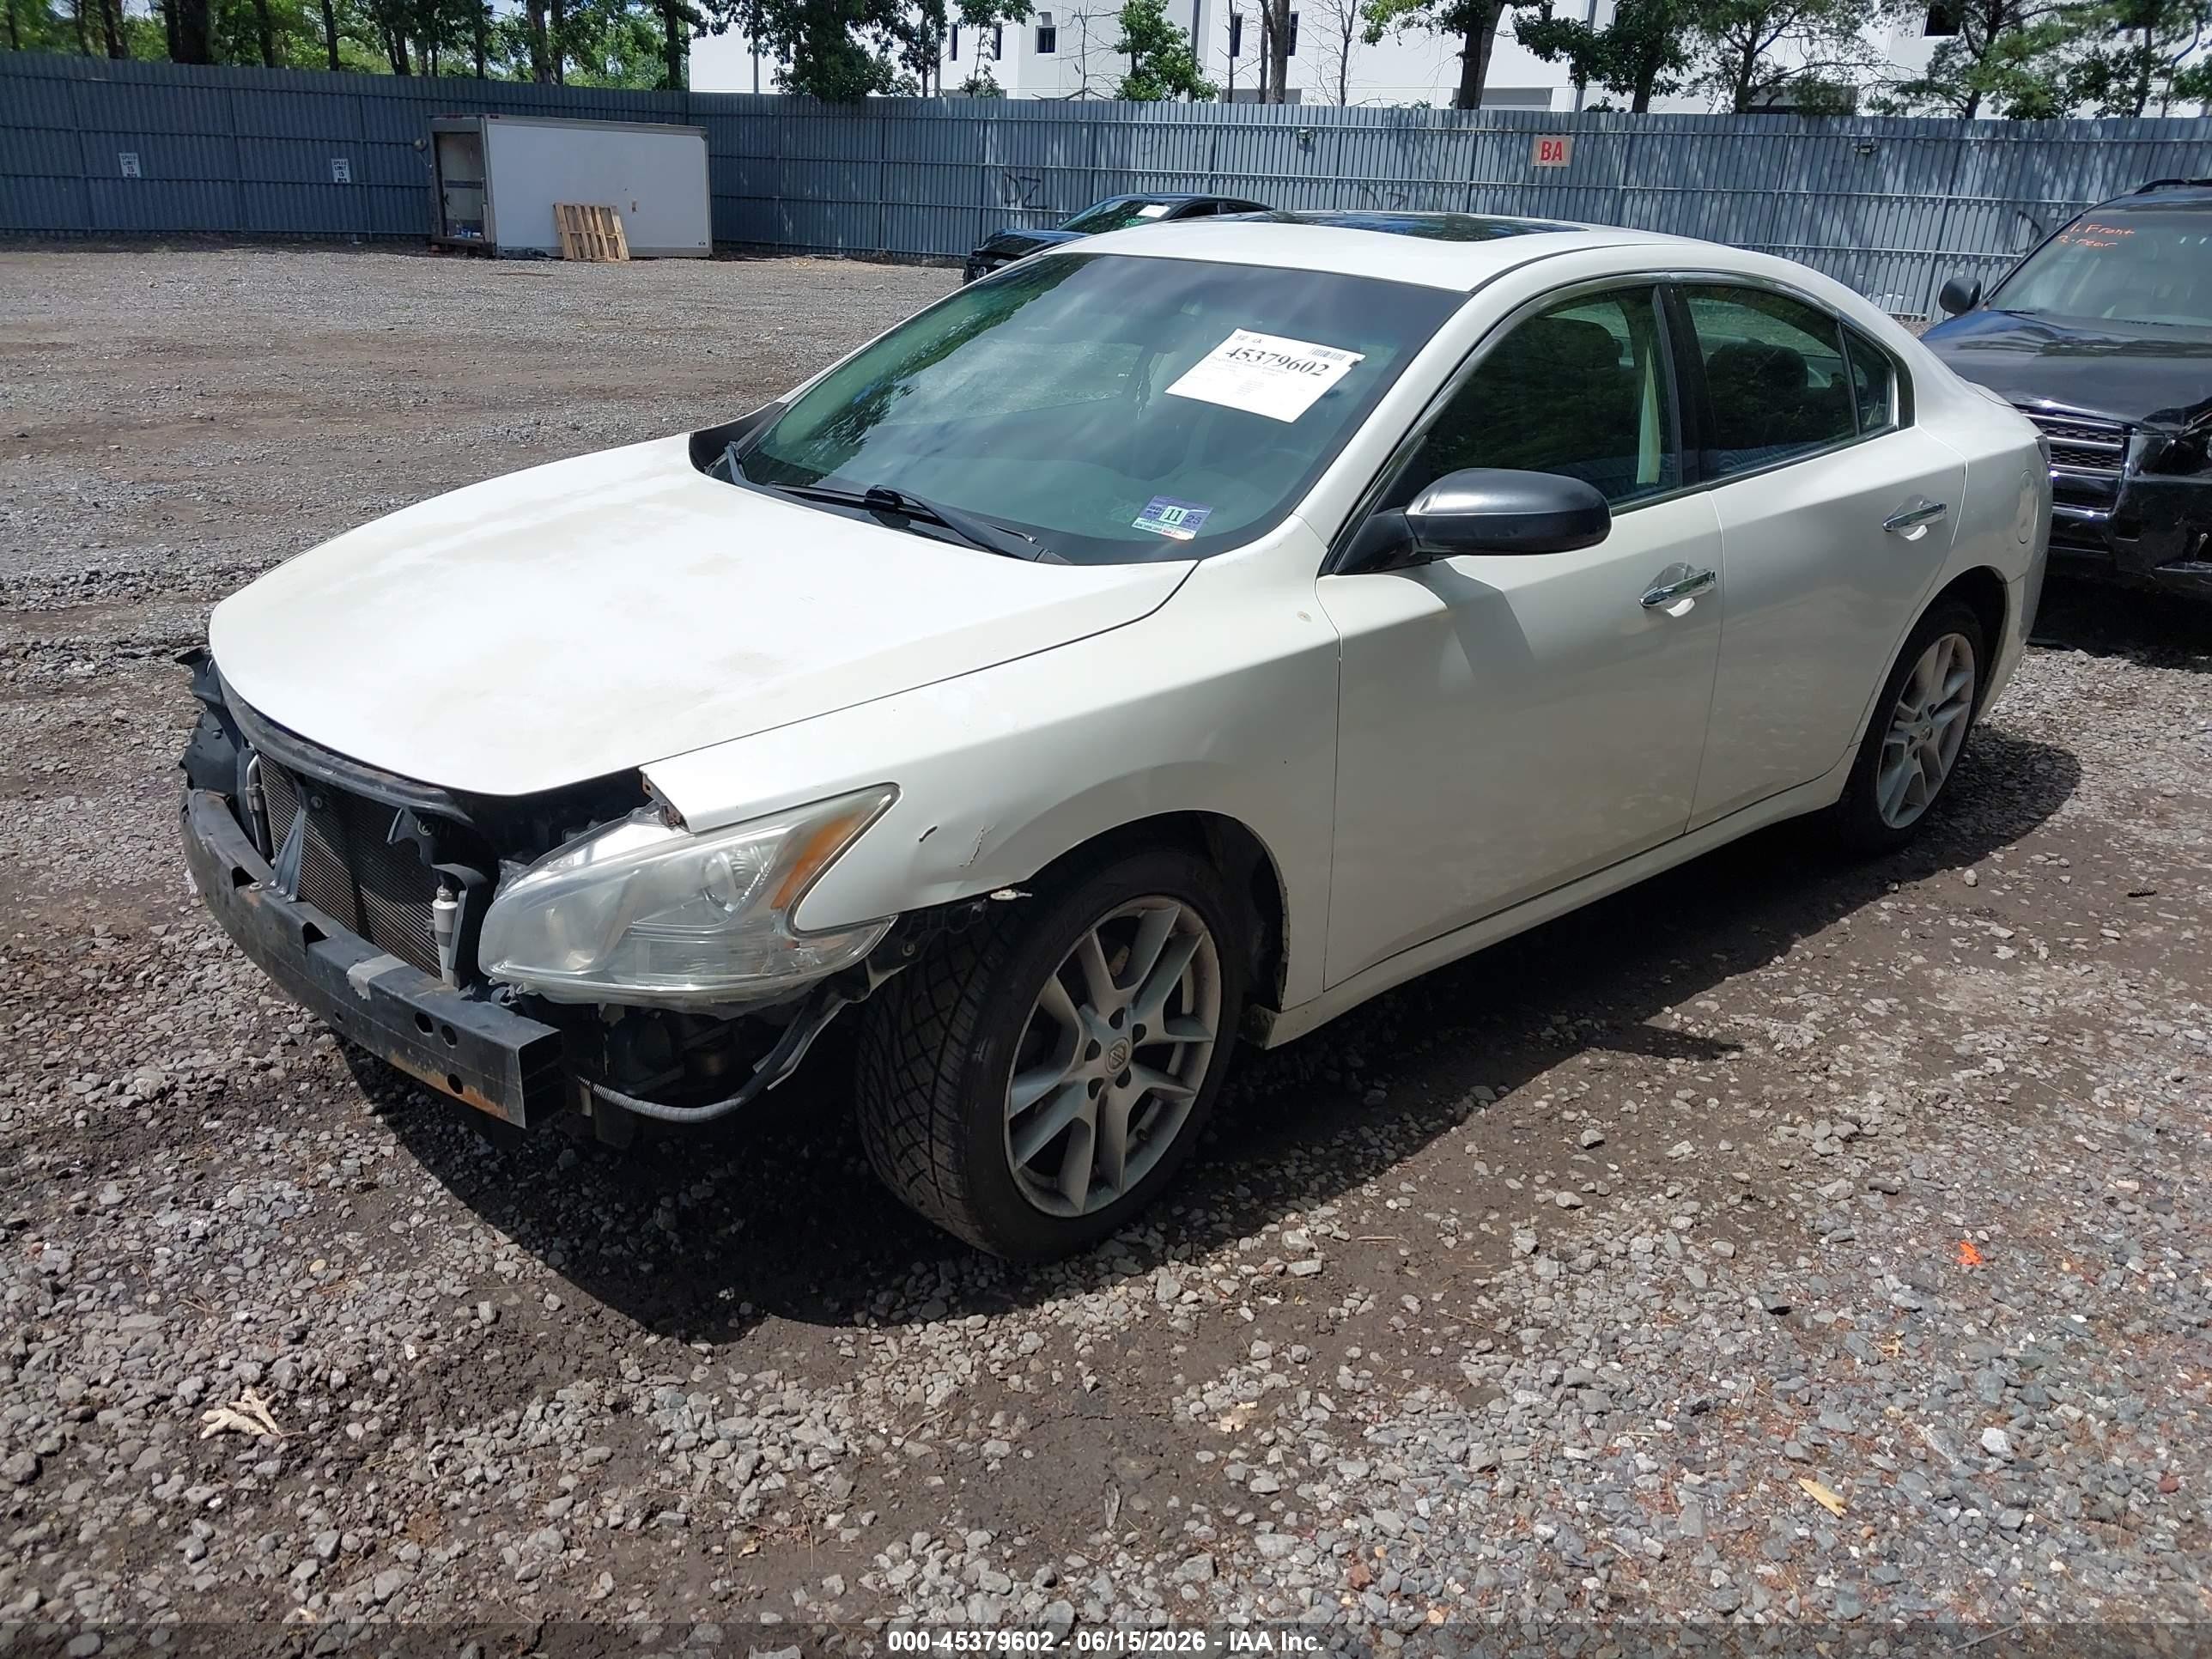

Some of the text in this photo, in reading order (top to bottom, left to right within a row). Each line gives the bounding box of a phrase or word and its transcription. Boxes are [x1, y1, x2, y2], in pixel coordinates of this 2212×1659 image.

[1540, 140, 1563, 161] BA
[2085, 223, 2136, 235] Front
[1225, 346, 1330, 377] 45379602
[1164, 508, 1183, 522] 11
